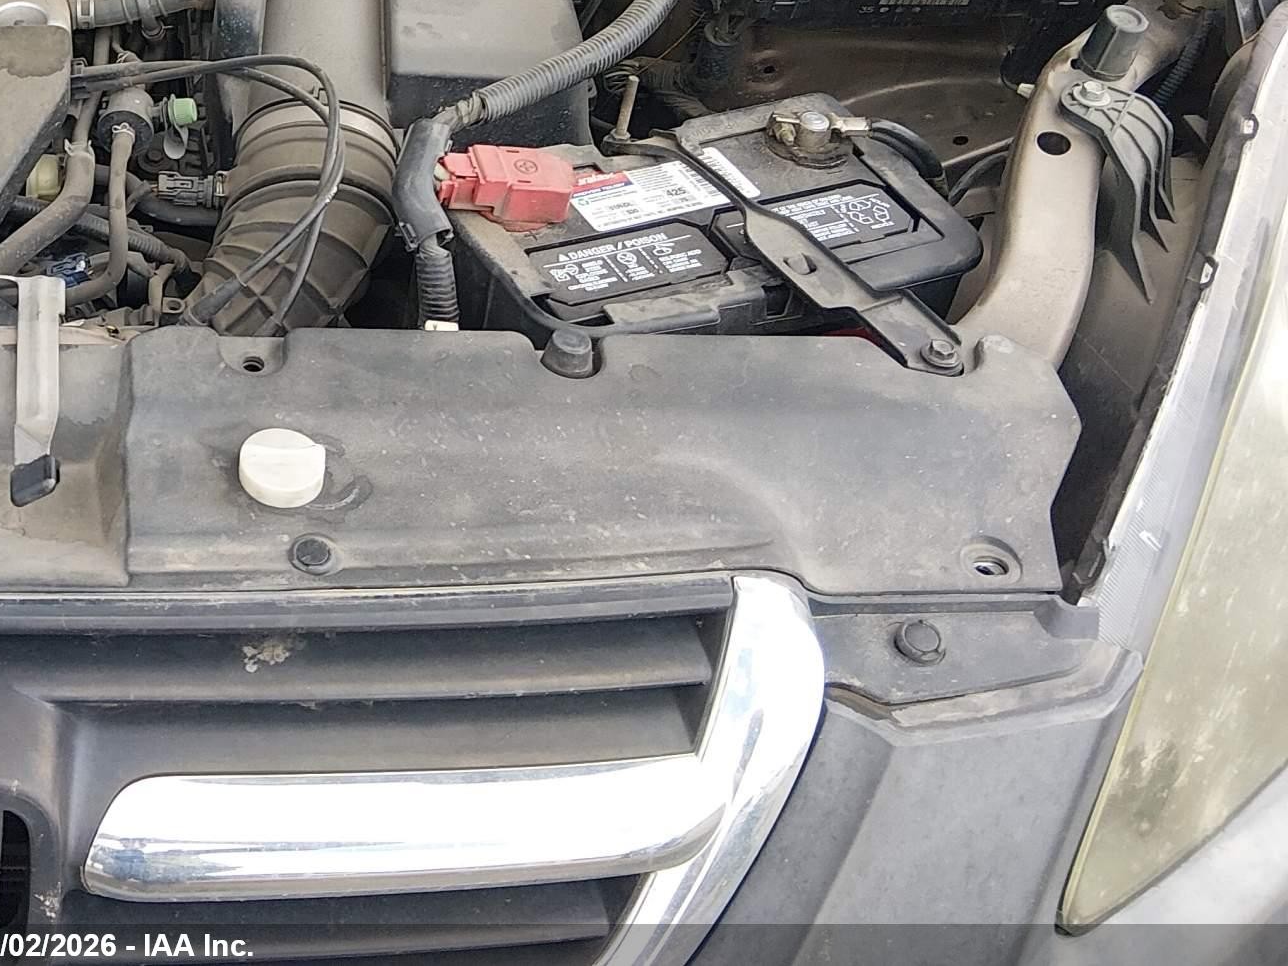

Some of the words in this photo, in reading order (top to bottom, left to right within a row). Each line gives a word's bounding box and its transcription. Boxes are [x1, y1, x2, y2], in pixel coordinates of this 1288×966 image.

[666, 187, 688, 198] 425
[567, 244, 617, 260] DANGER
[623, 233, 668, 248] POISON
